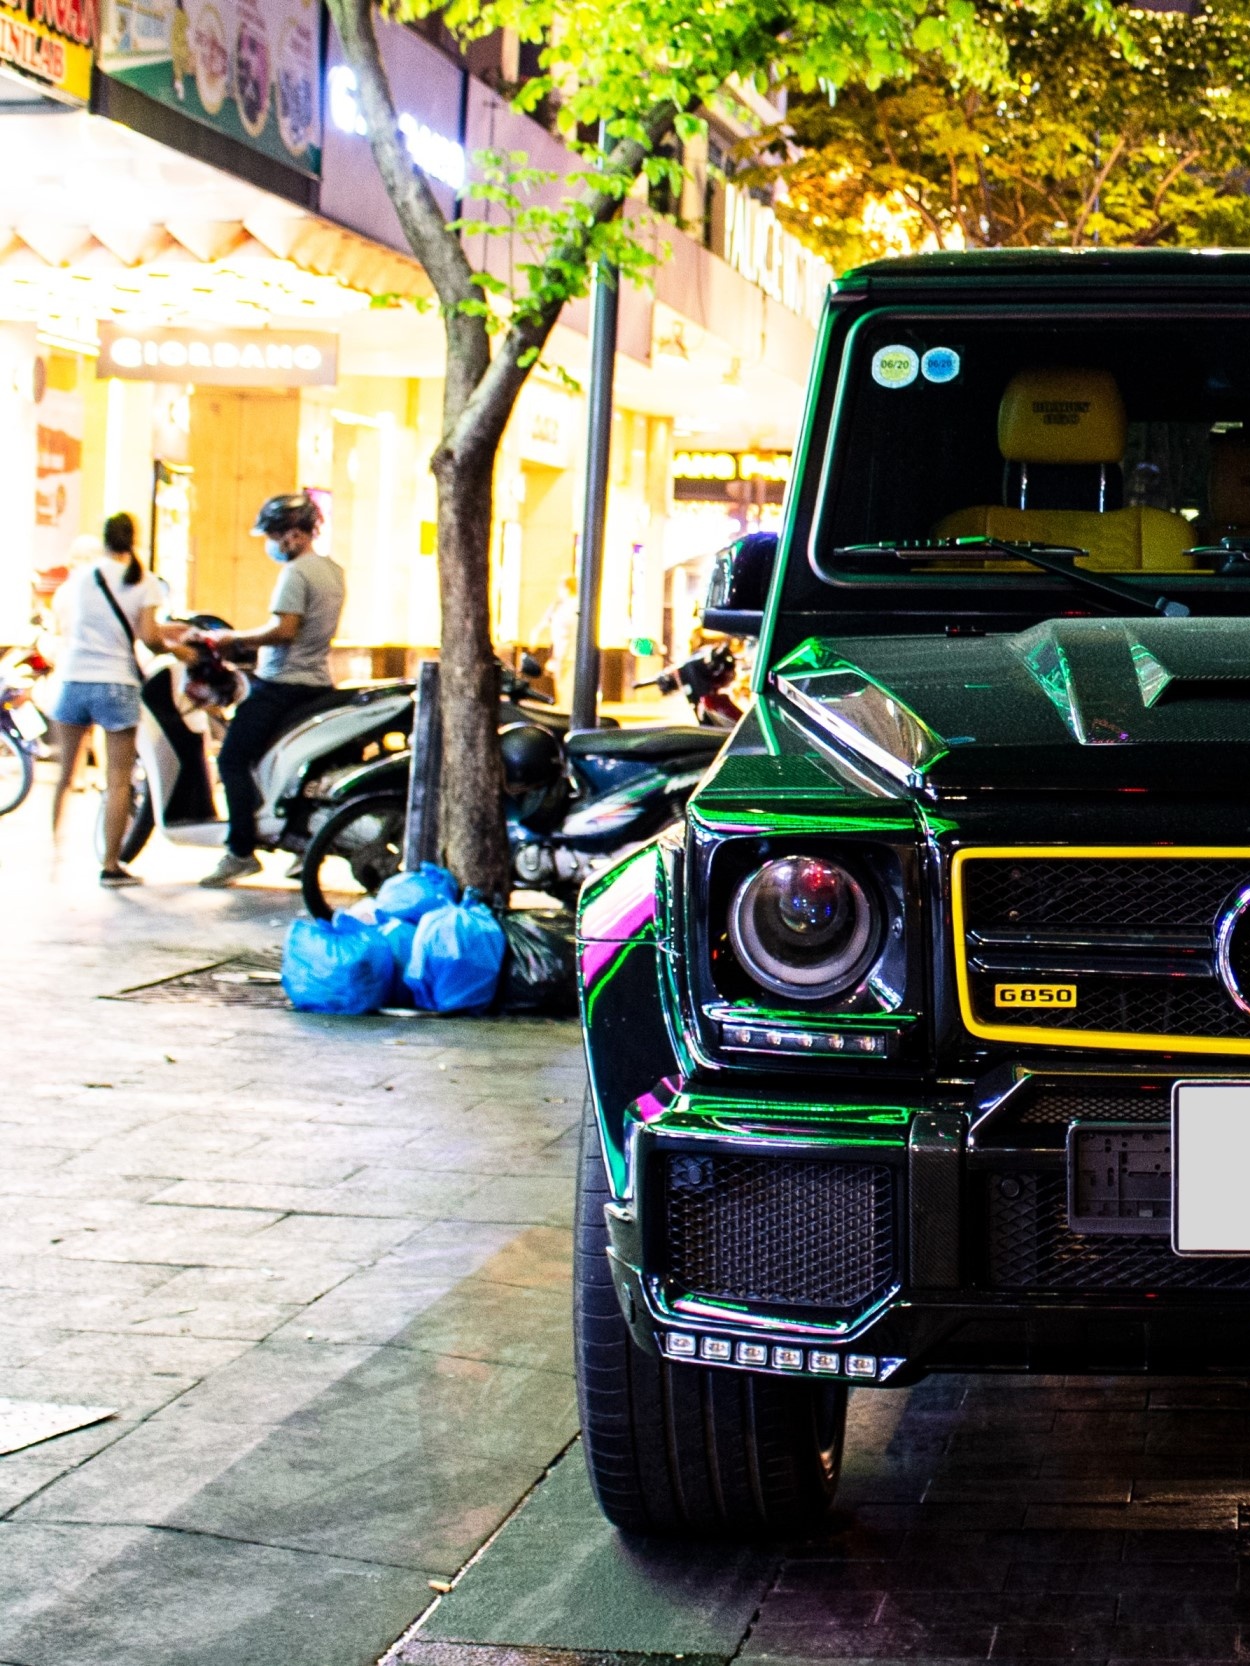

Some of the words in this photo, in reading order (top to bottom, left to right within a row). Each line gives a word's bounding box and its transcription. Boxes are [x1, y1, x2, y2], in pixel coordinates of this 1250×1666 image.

[110, 336, 322, 370] GIORDANO
[880, 360, 910, 370] 06/20
[927, 360, 953, 369] 06/20
